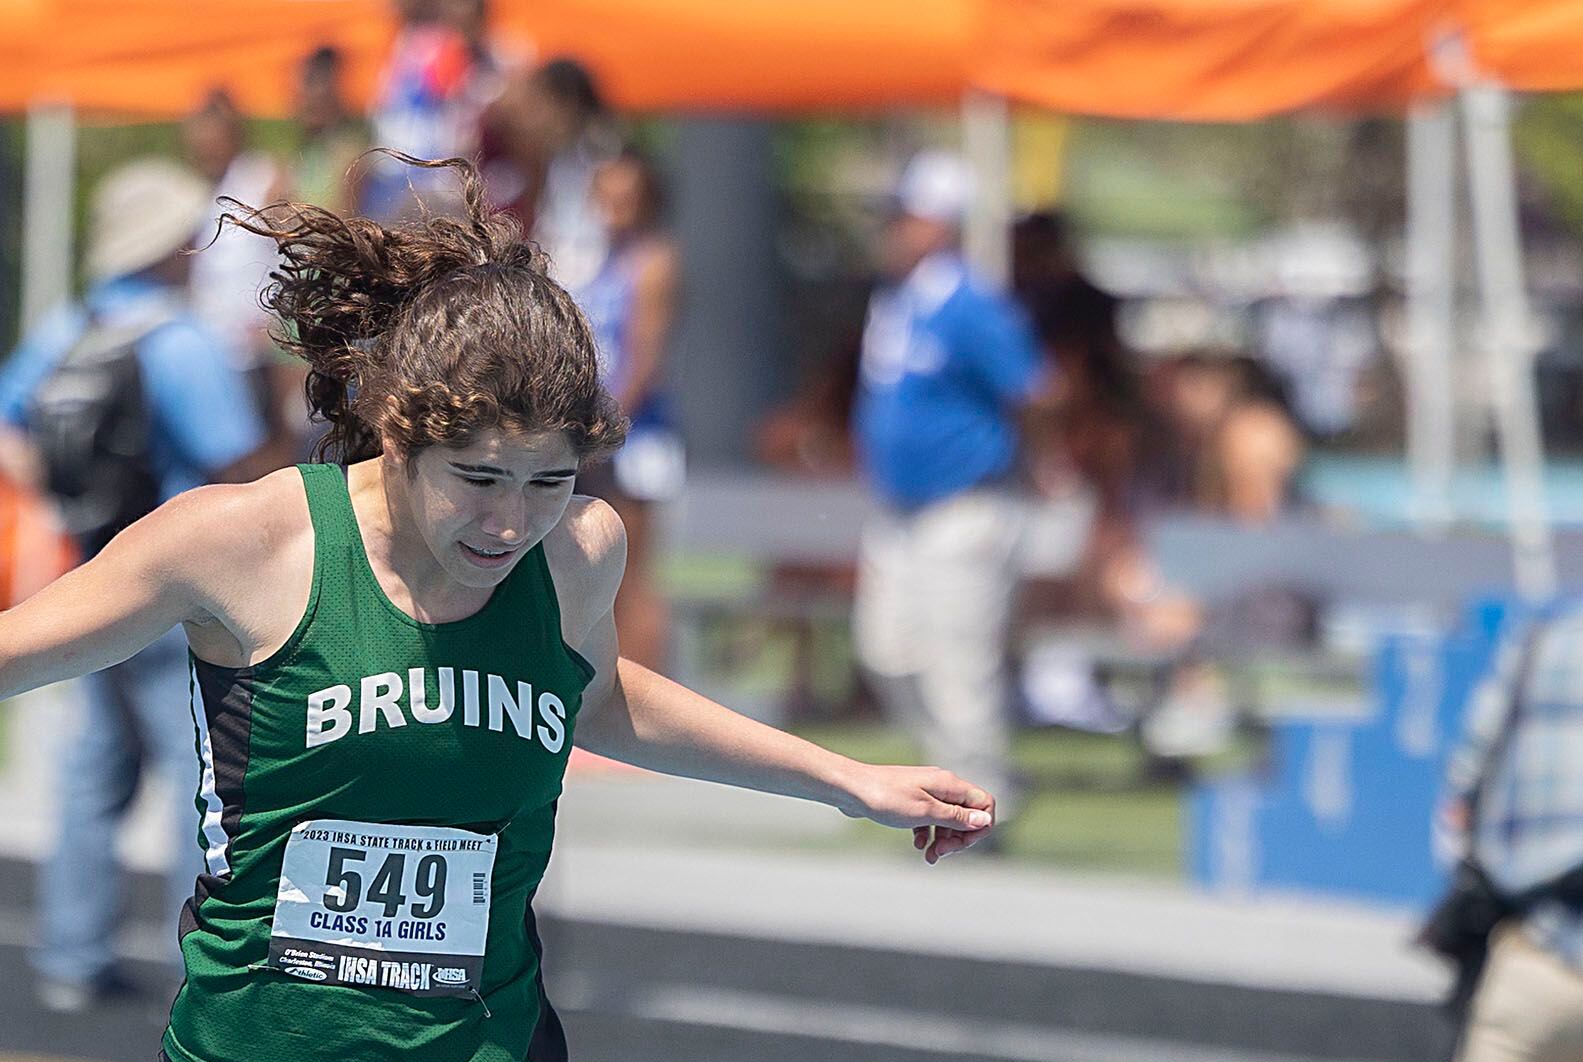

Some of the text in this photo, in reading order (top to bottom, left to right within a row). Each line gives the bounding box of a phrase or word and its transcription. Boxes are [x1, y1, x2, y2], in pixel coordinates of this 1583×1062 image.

[305, 666, 566, 754] BRUINS
[303, 829, 483, 851] 2023 IHSA STATE TRACK & FIELD MEET
[322, 846, 448, 919] 549
[310, 911, 447, 941] CLASS 1A GIRLS
[337, 955, 432, 991] IHSA TRACK
